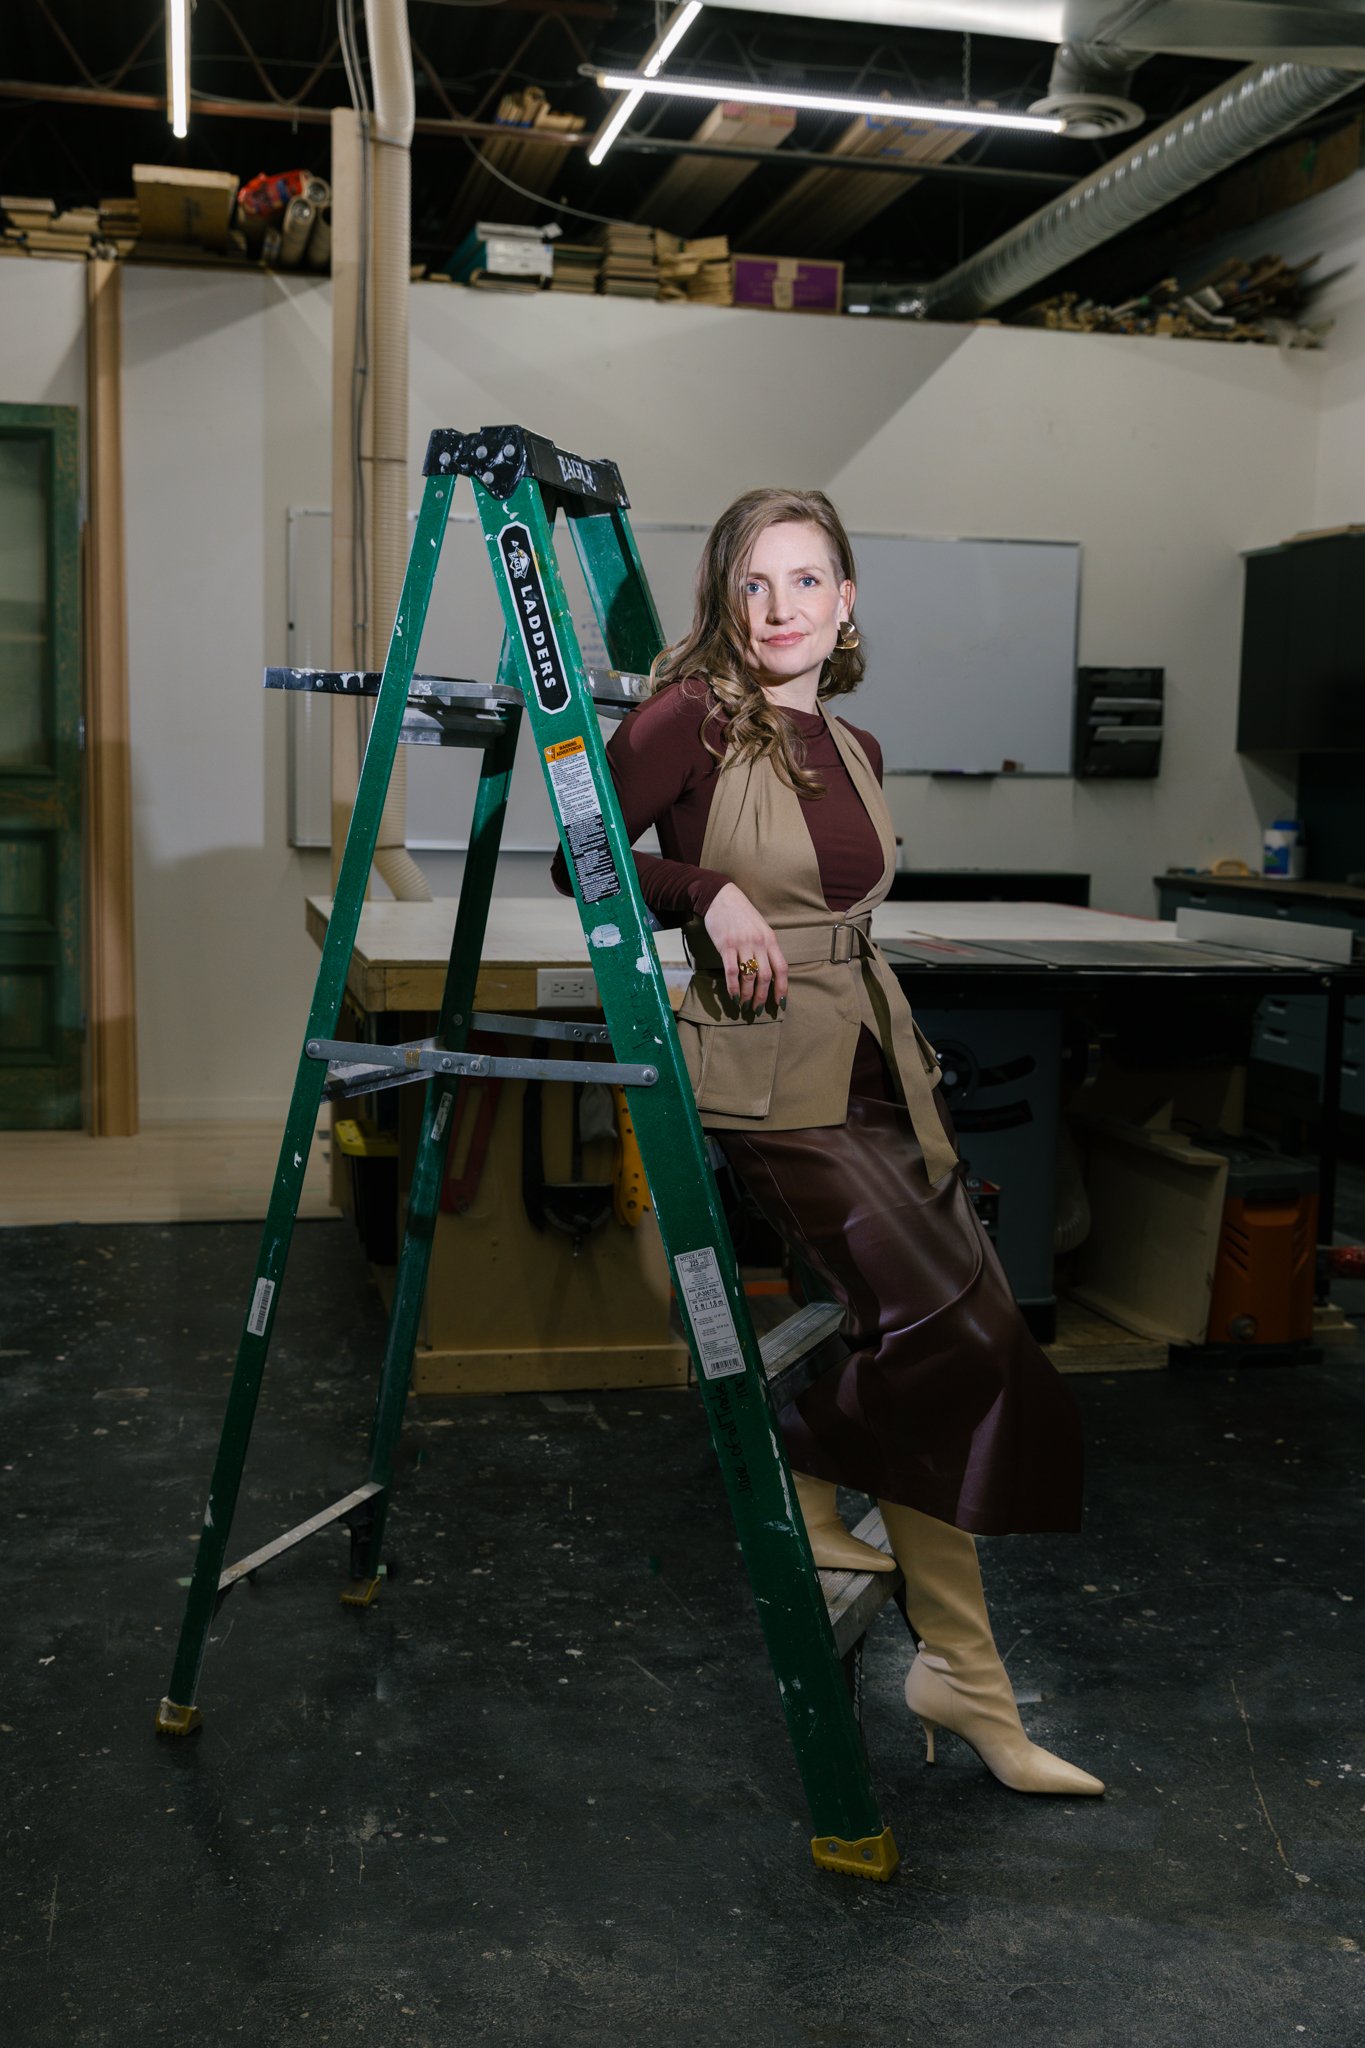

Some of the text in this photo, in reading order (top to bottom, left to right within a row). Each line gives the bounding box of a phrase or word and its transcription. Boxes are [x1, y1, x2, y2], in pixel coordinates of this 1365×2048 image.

[557, 455, 597, 492] EAGLE
[512, 552, 524, 577] EAGLE
[520, 584, 556, 689] LADDERS
[559, 740, 577, 750] WARNING
[718, 1420, 737, 1436] all
[723, 1437, 743, 1456] of
